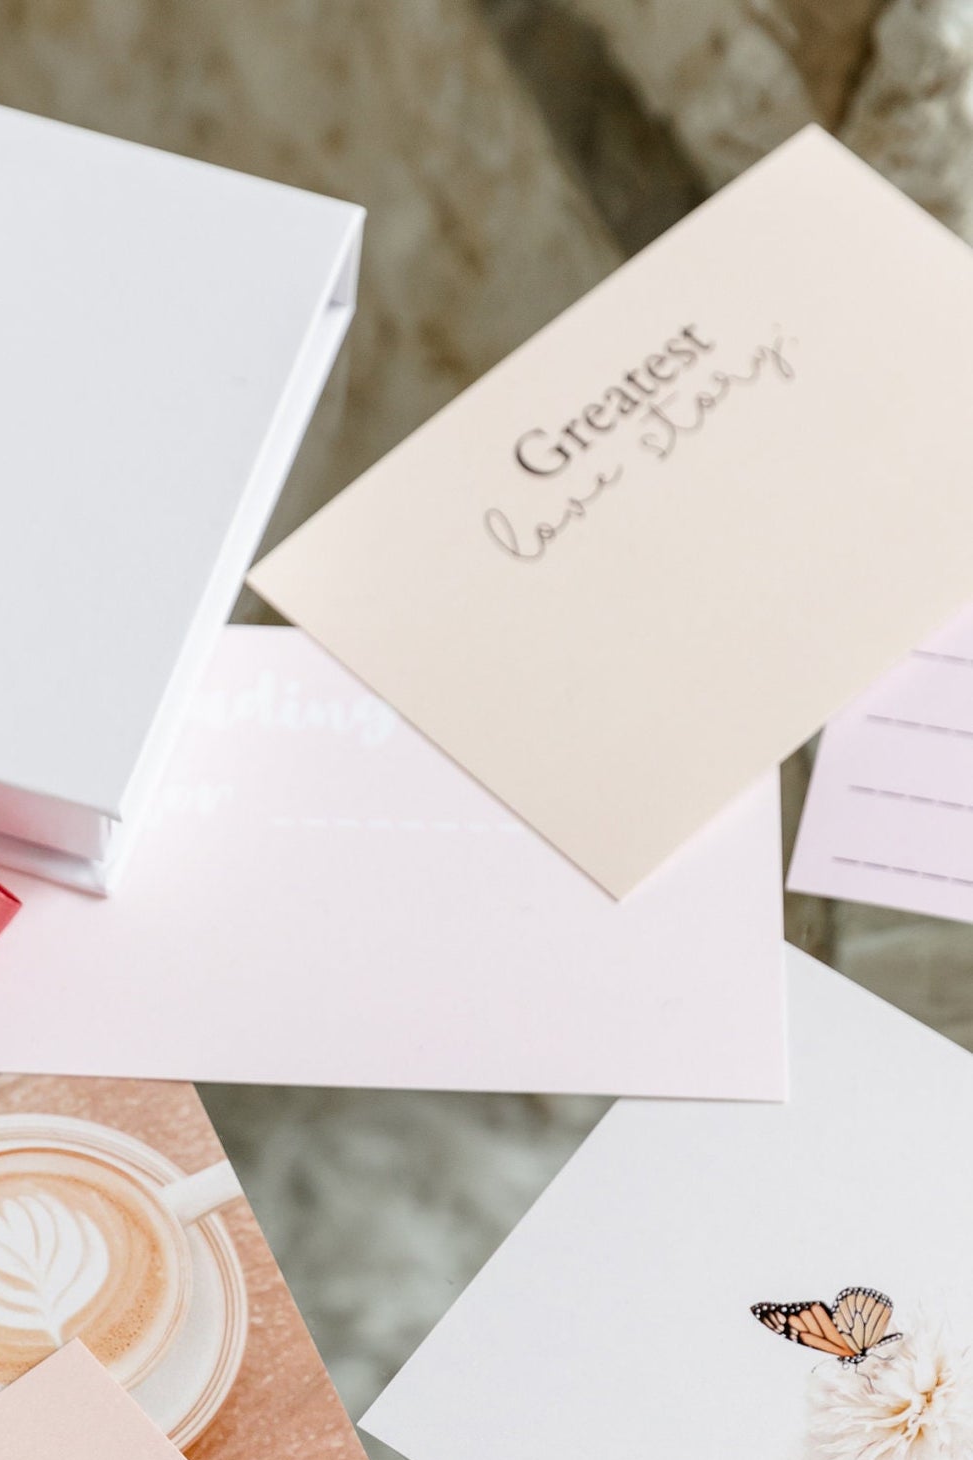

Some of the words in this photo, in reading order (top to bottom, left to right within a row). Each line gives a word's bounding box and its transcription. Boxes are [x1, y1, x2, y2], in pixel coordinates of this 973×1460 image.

[484, 465, 623, 563] love
[641, 323, 799, 462] story
[514, 322, 716, 478] Greatest
